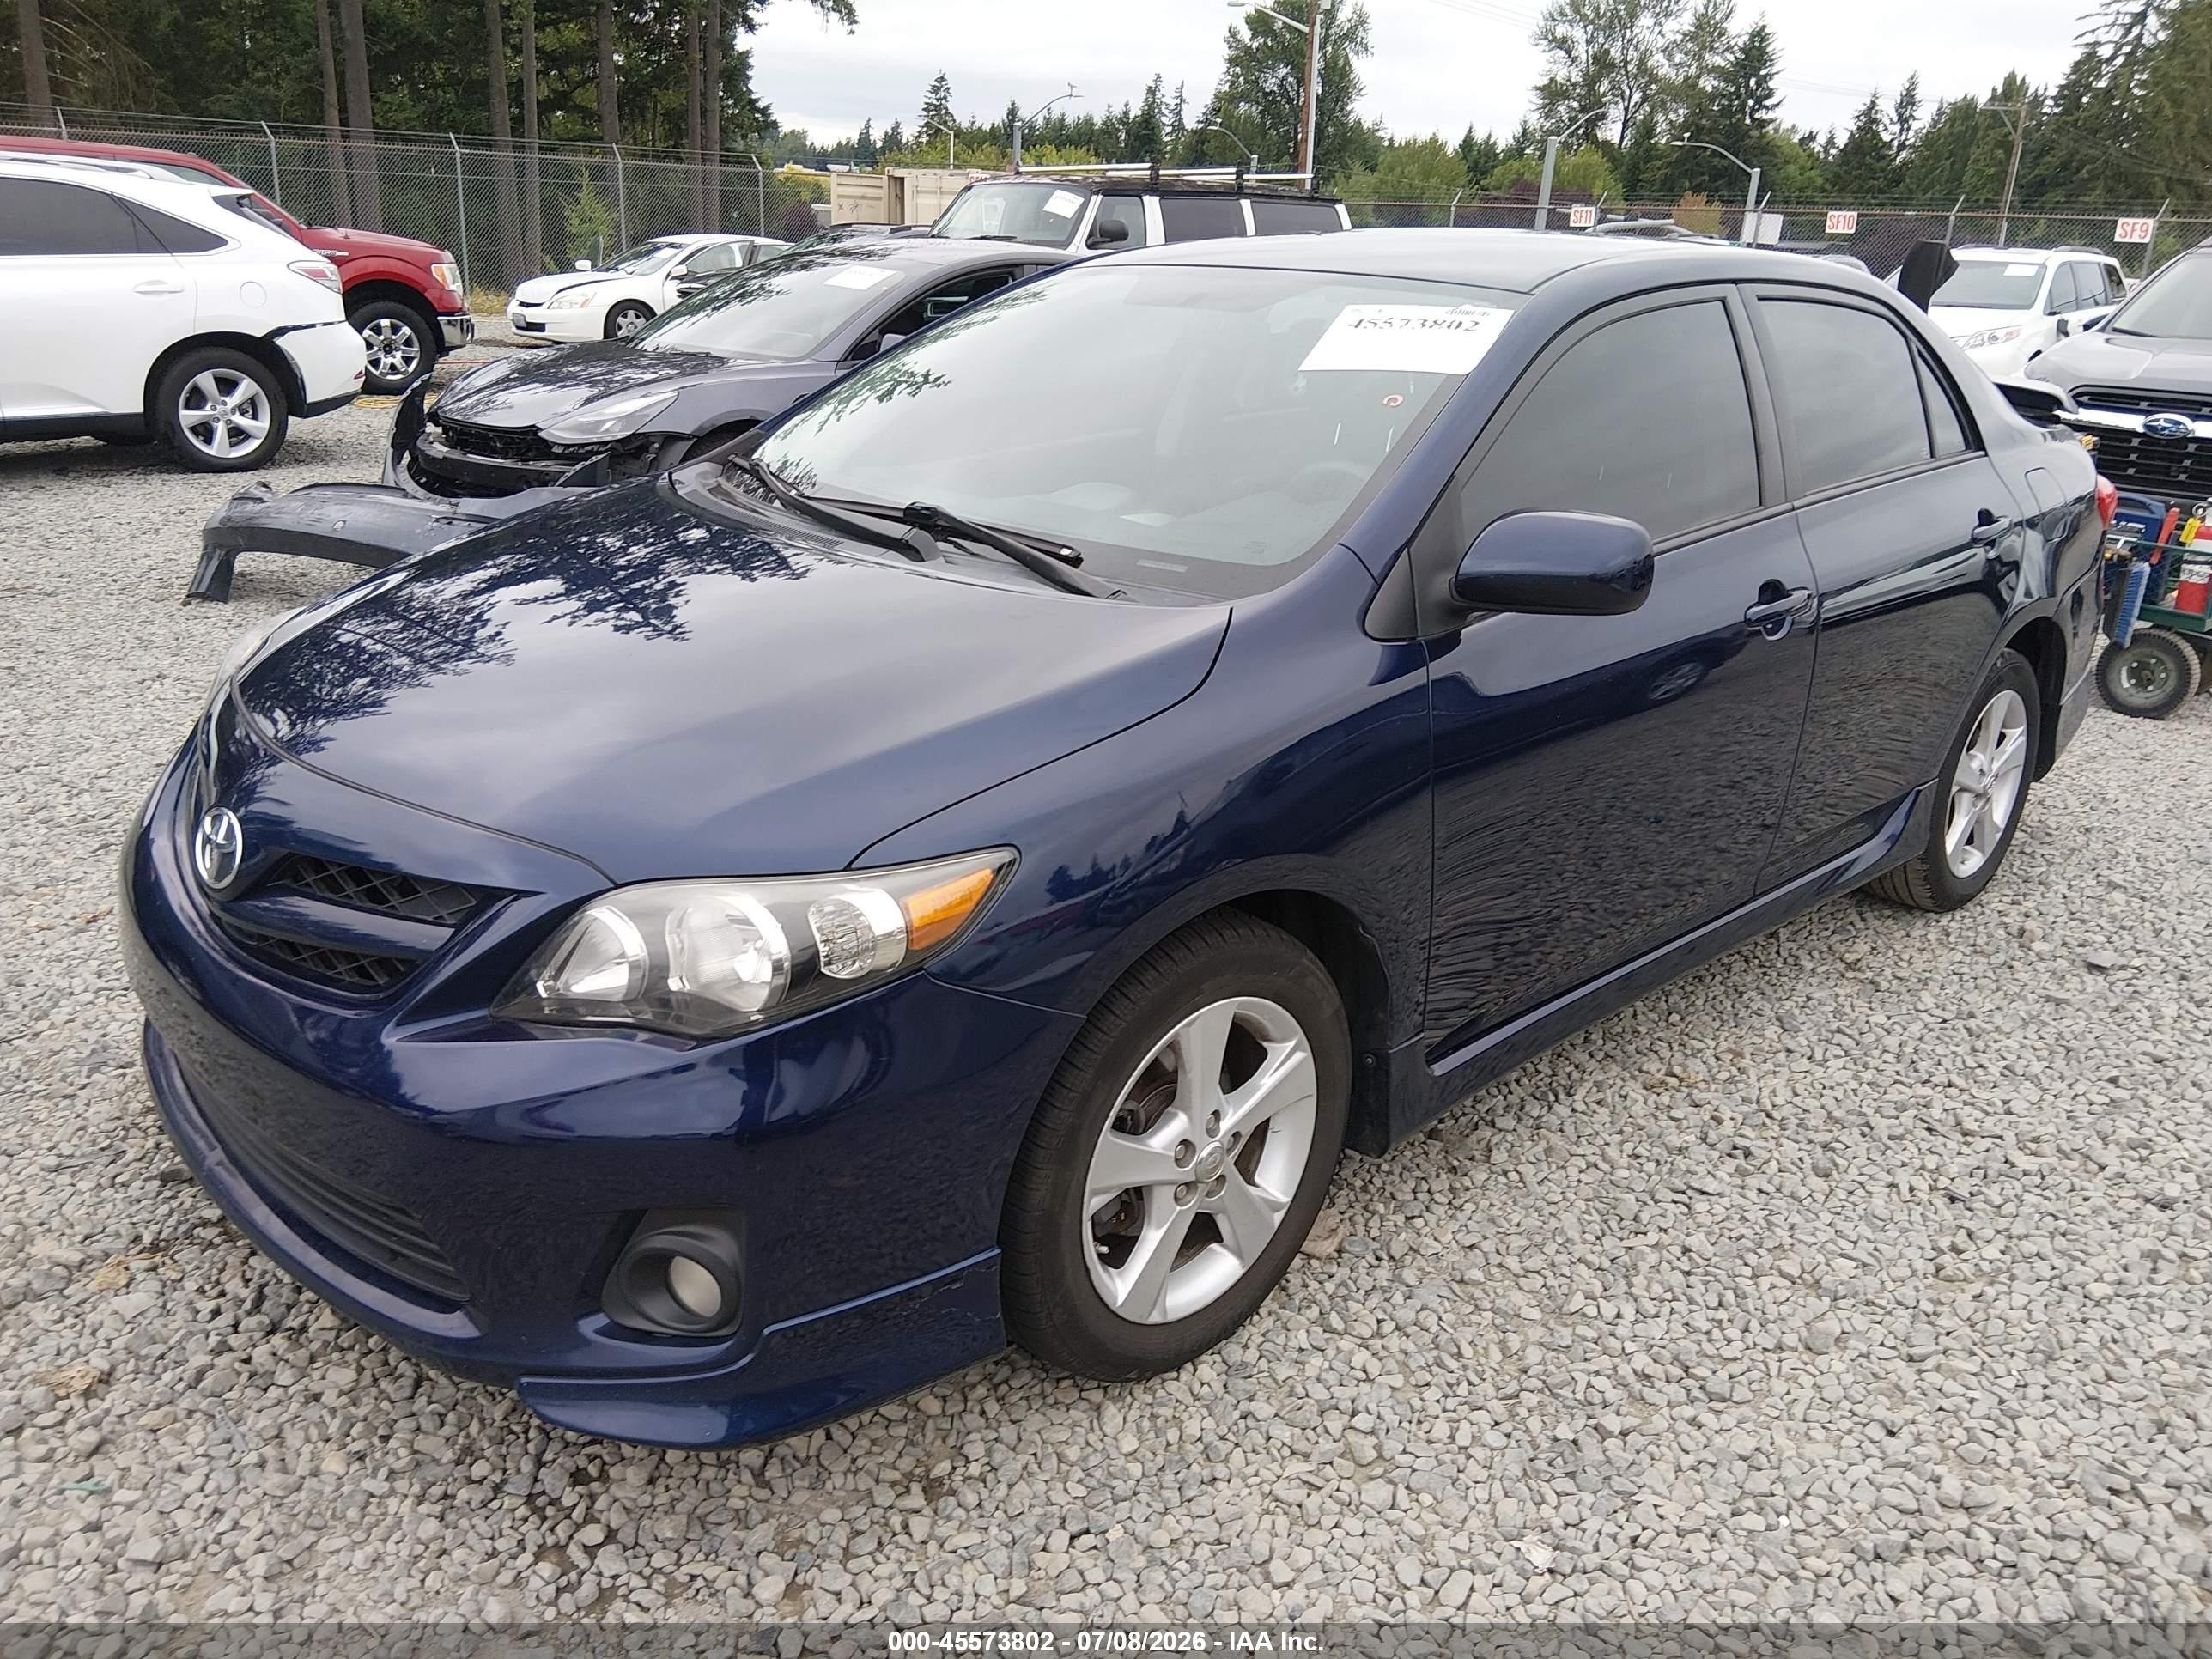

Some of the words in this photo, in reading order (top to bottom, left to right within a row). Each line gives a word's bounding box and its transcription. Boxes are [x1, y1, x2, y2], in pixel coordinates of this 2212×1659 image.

[1572, 209, 1593, 224] SF11
[1828, 214, 1855, 230] SF10
[2118, 221, 2150, 240] SF9
